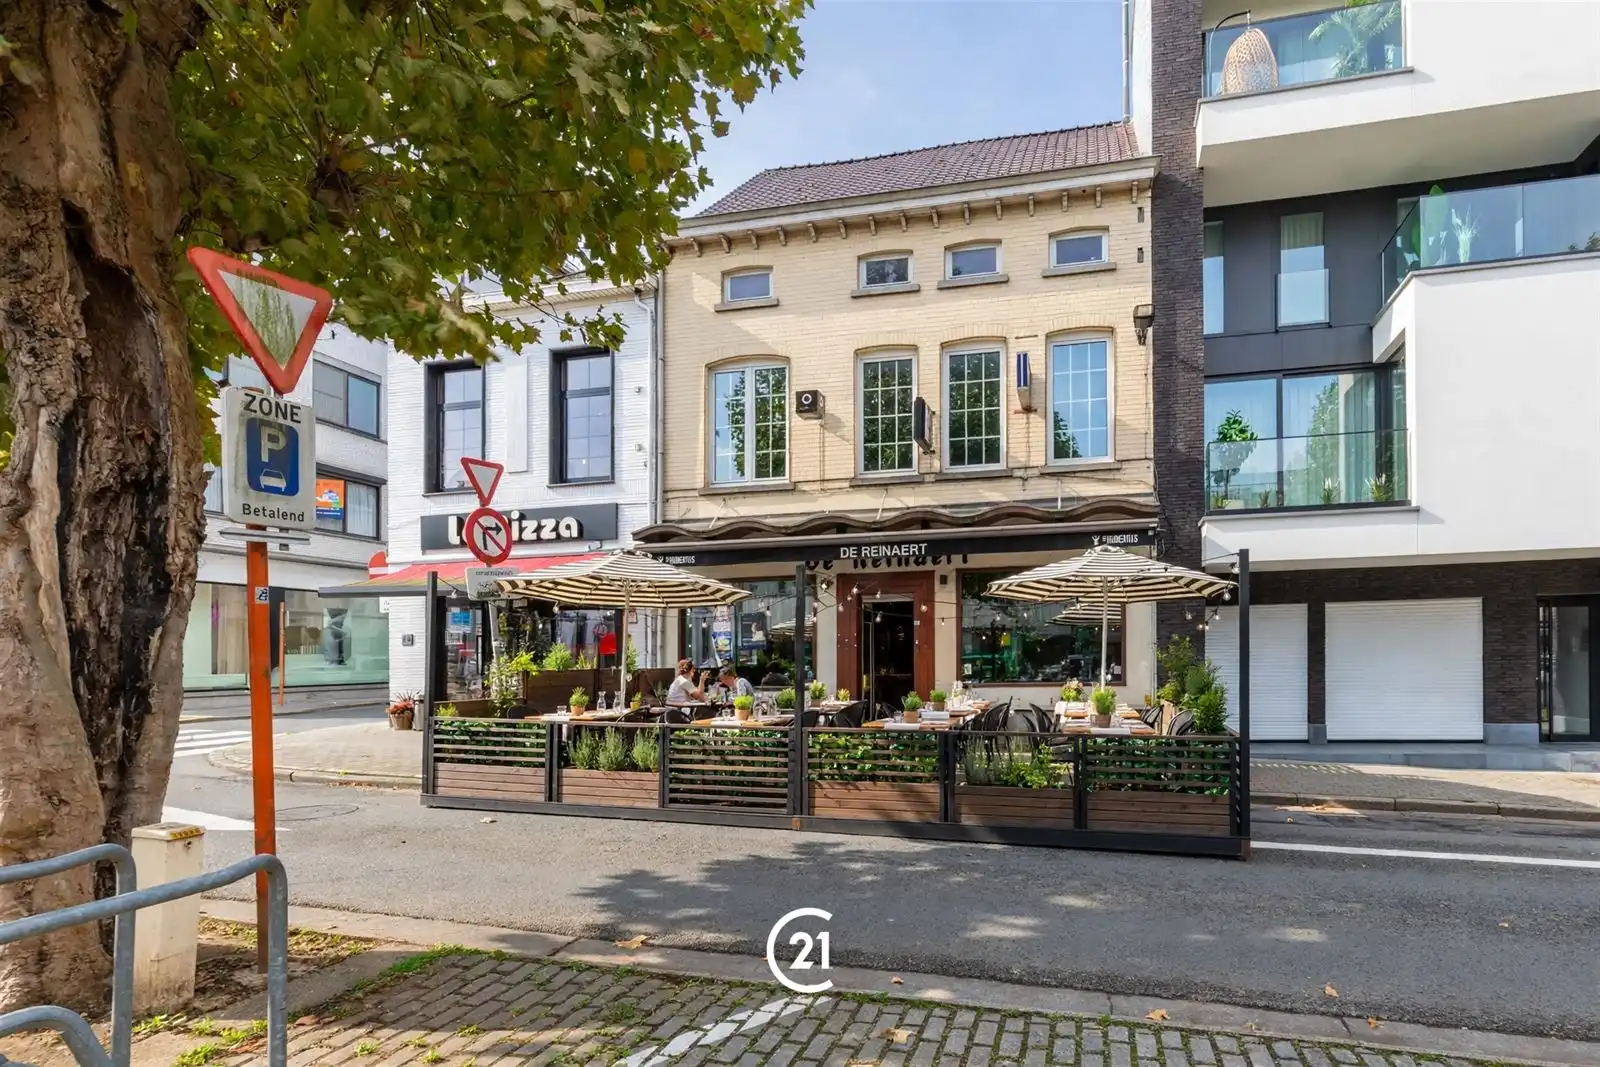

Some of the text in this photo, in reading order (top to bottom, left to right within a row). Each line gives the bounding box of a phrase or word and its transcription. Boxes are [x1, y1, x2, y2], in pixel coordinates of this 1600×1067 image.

[244, 393, 301, 423] ZONE
[261, 426, 287, 462] P
[242, 503, 305, 522] Betalend
[502, 510, 579, 541] izza
[840, 543, 928, 559] DE REINAERT
